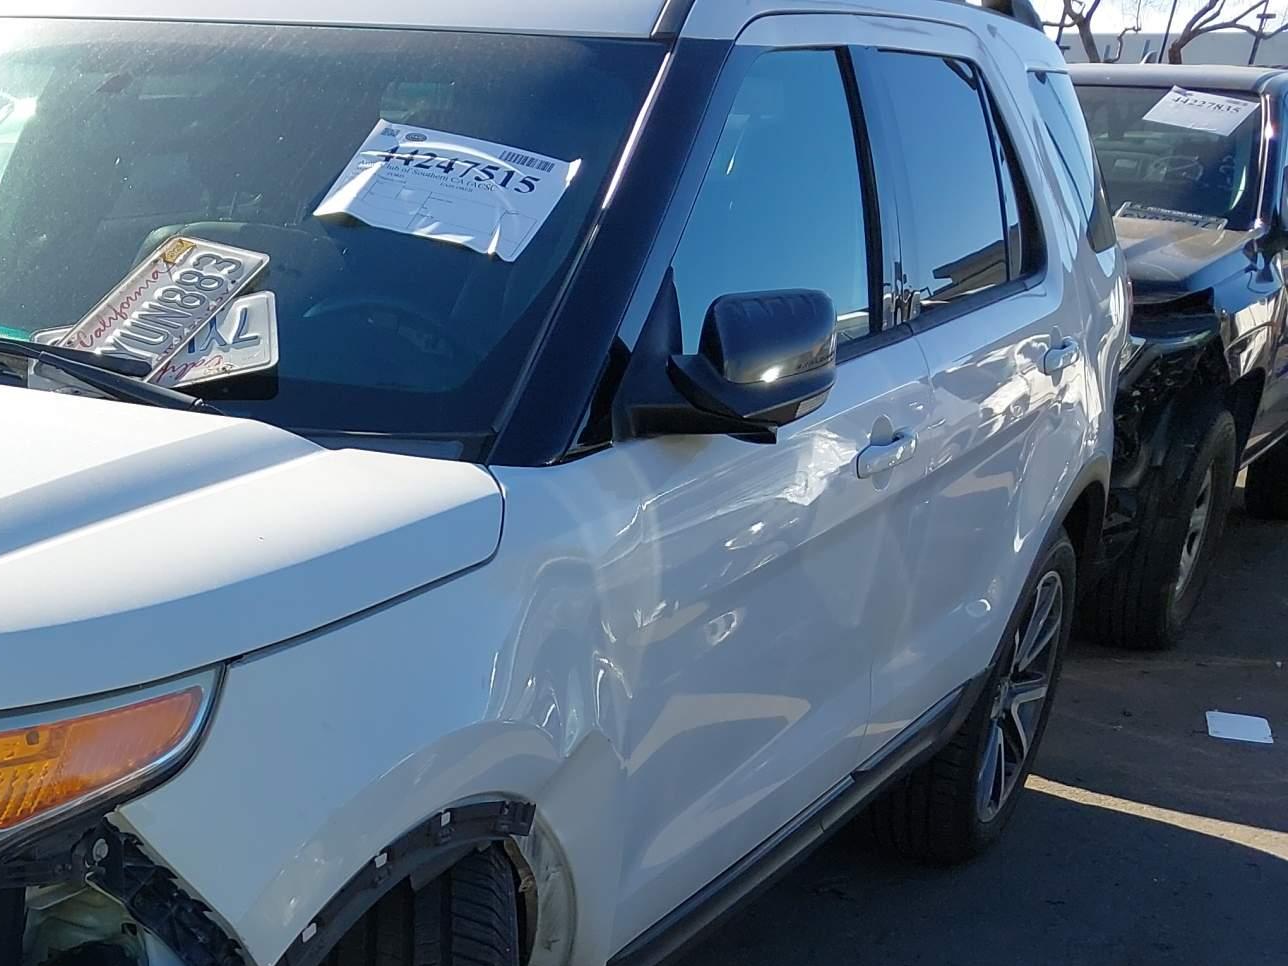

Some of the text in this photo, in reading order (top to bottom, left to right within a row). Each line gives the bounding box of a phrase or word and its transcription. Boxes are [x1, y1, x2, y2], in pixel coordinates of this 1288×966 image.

[377, 145, 541, 193] 44247515
[414, 168, 448, 182] Southern
[77, 264, 175, 348] California
[95, 251, 244, 364] YUN883
